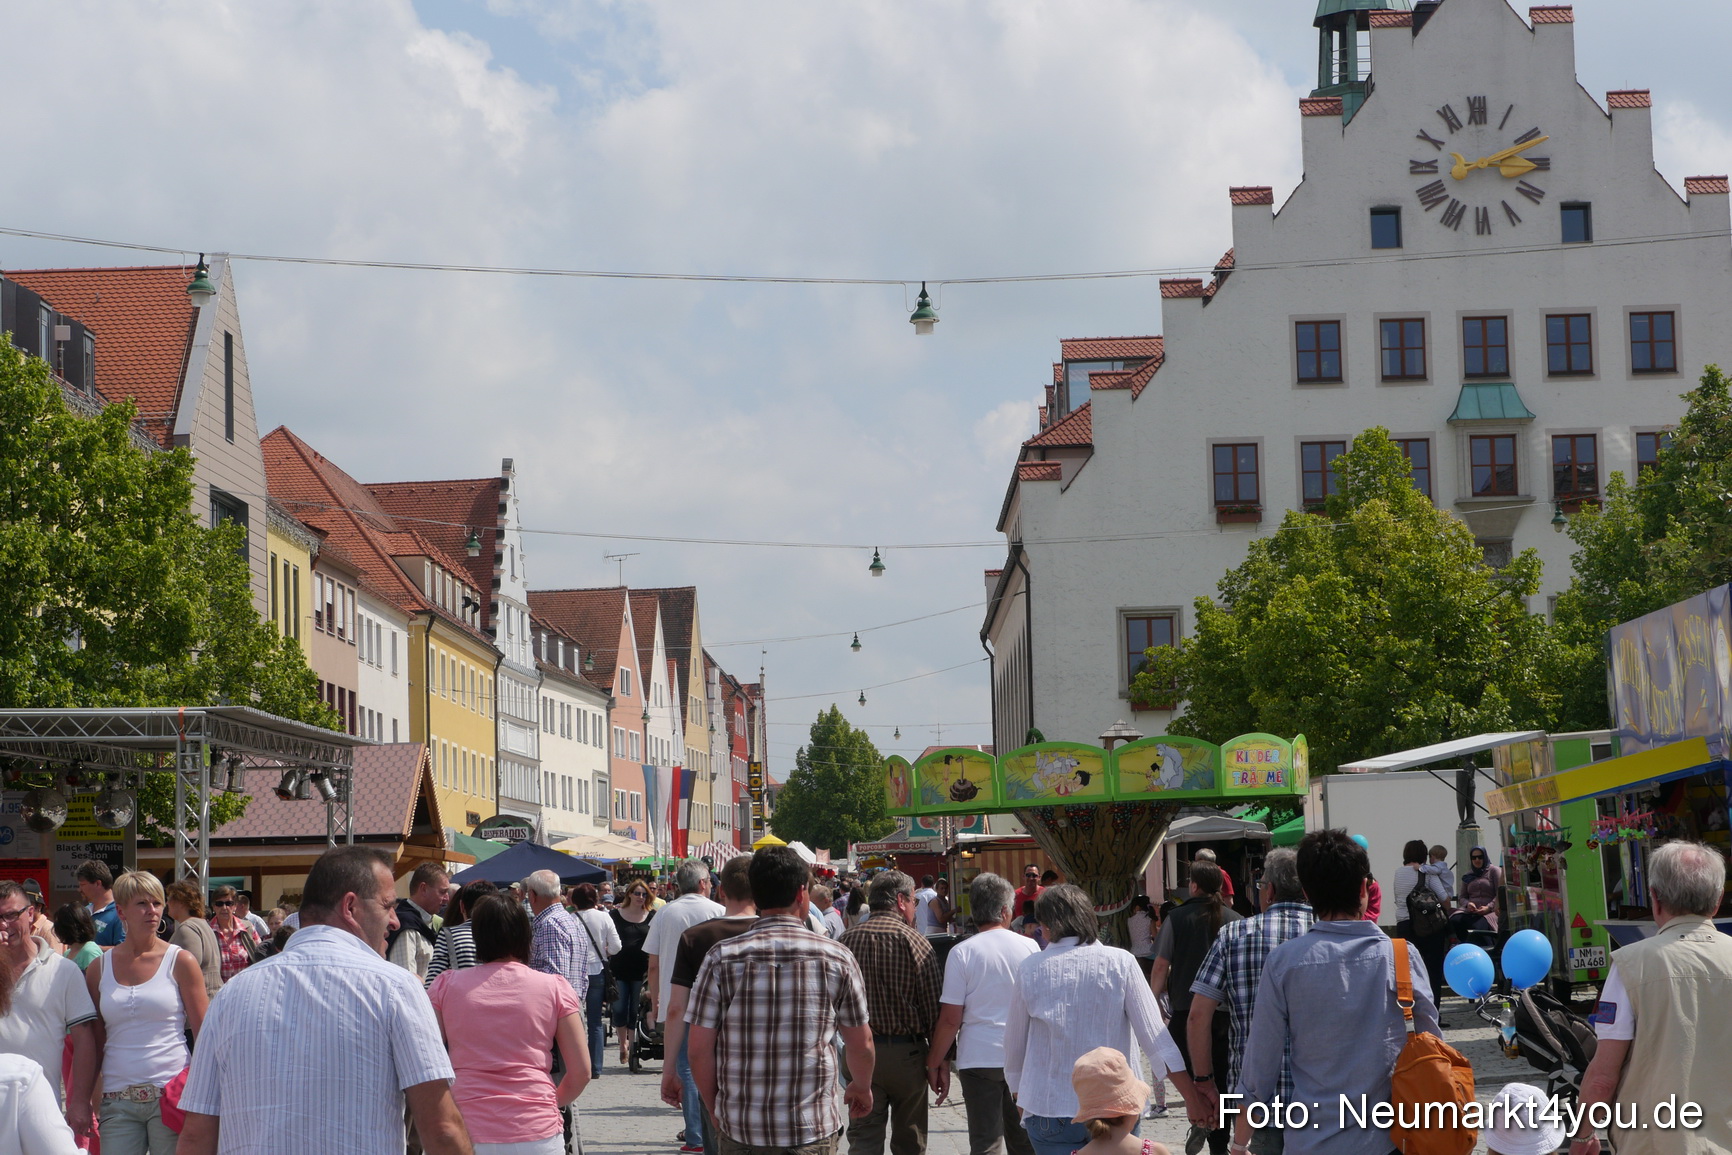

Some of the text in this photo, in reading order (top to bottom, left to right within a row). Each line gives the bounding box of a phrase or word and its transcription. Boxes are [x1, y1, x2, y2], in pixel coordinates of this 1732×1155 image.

[1236, 749, 1280, 763] KINDER
[1232, 766, 1283, 785] TRÄUME
[749, 763, 762, 829] HOTEL
[484, 828, 527, 838] DESPERADOS
[56, 843, 82, 851] Black
[94, 843, 123, 851] White
[859, 843, 887, 851] POPCORN
[71, 851, 108, 859] Session
[1579, 948, 1592, 958] NM
[1574, 957, 1604, 968] JA 468
